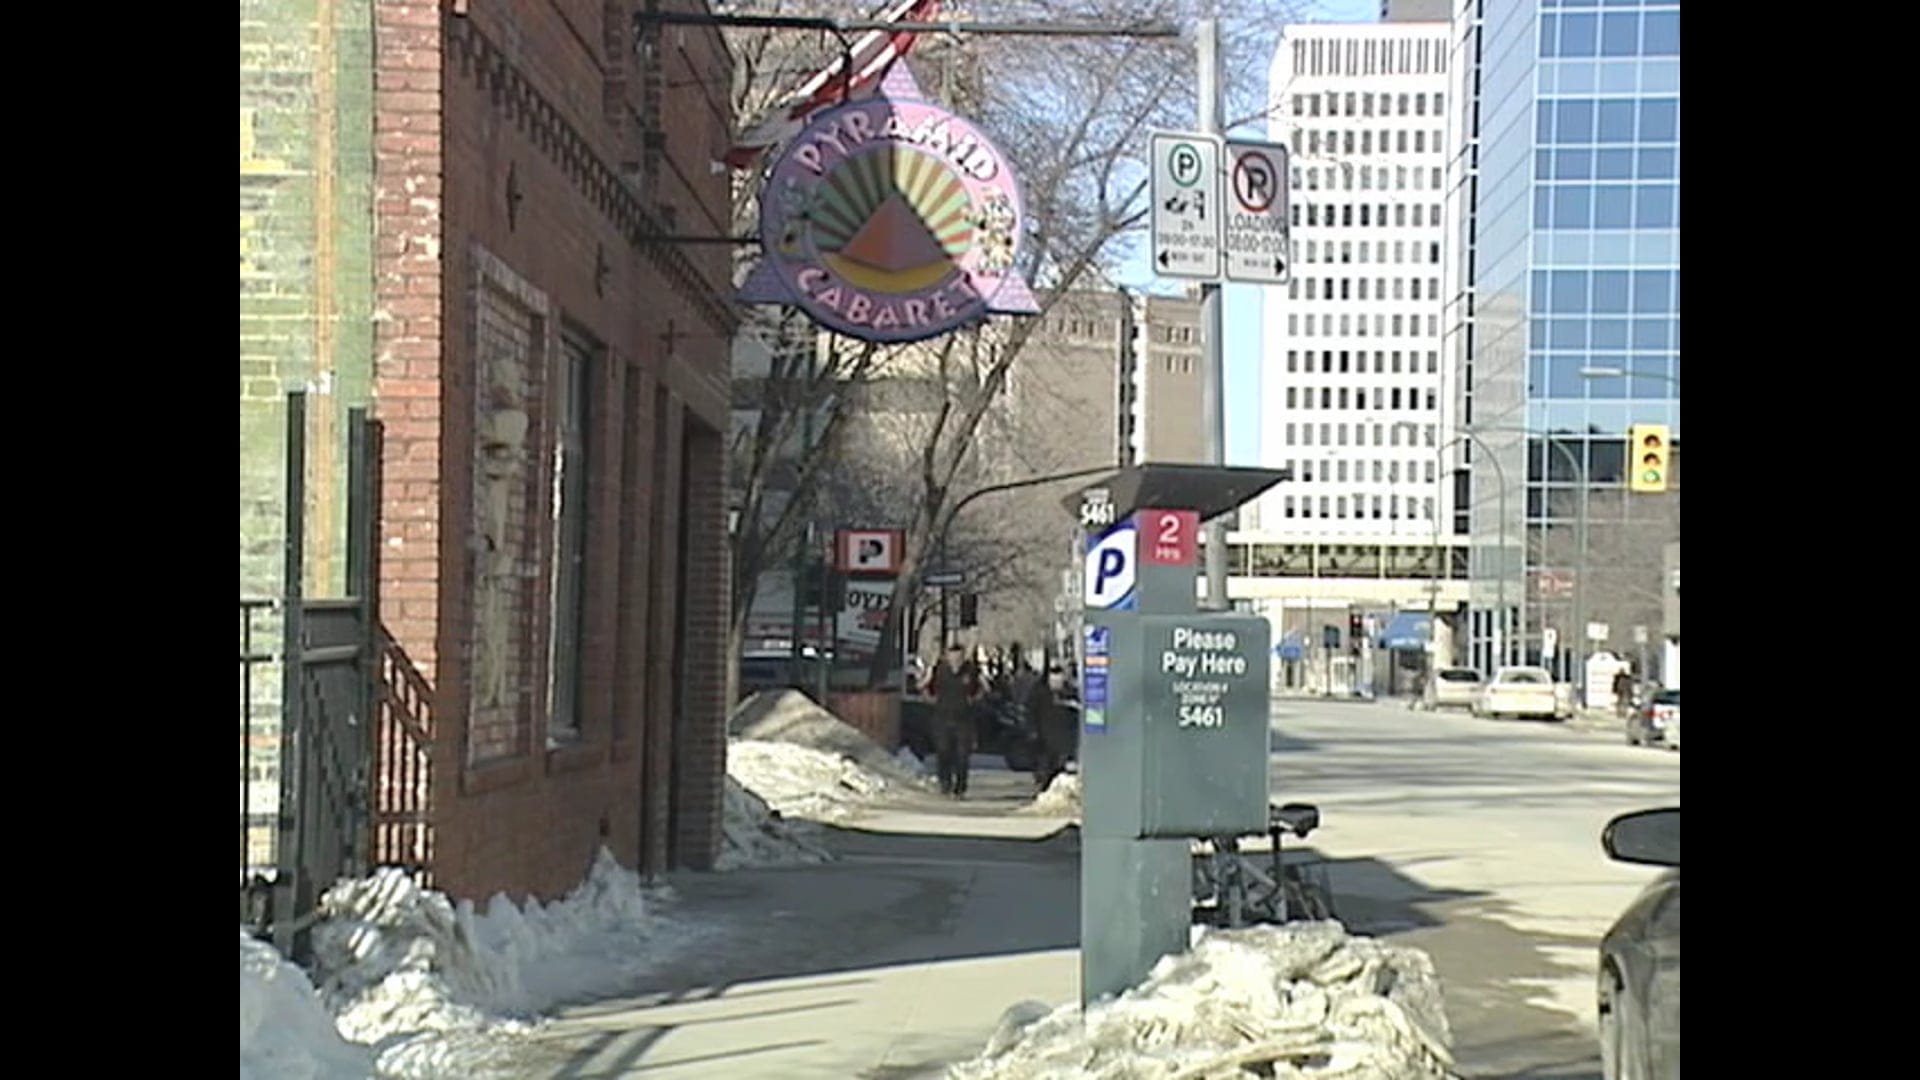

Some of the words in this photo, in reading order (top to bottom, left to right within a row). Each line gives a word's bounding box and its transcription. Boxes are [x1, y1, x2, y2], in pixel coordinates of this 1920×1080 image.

[796, 109, 999, 181] PYRAMID
[1178, 152, 1194, 178] P
[797, 268, 975, 330] CABARET
[1081, 503, 1114, 525] 5461
[1159, 514, 1180, 543] 2
[1094, 548, 1126, 595] P
[1173, 628, 1236, 649] Please
[1162, 653, 1196, 678] Pay
[1202, 654, 1246, 674] Here
[1178, 705, 1222, 728] 5461
